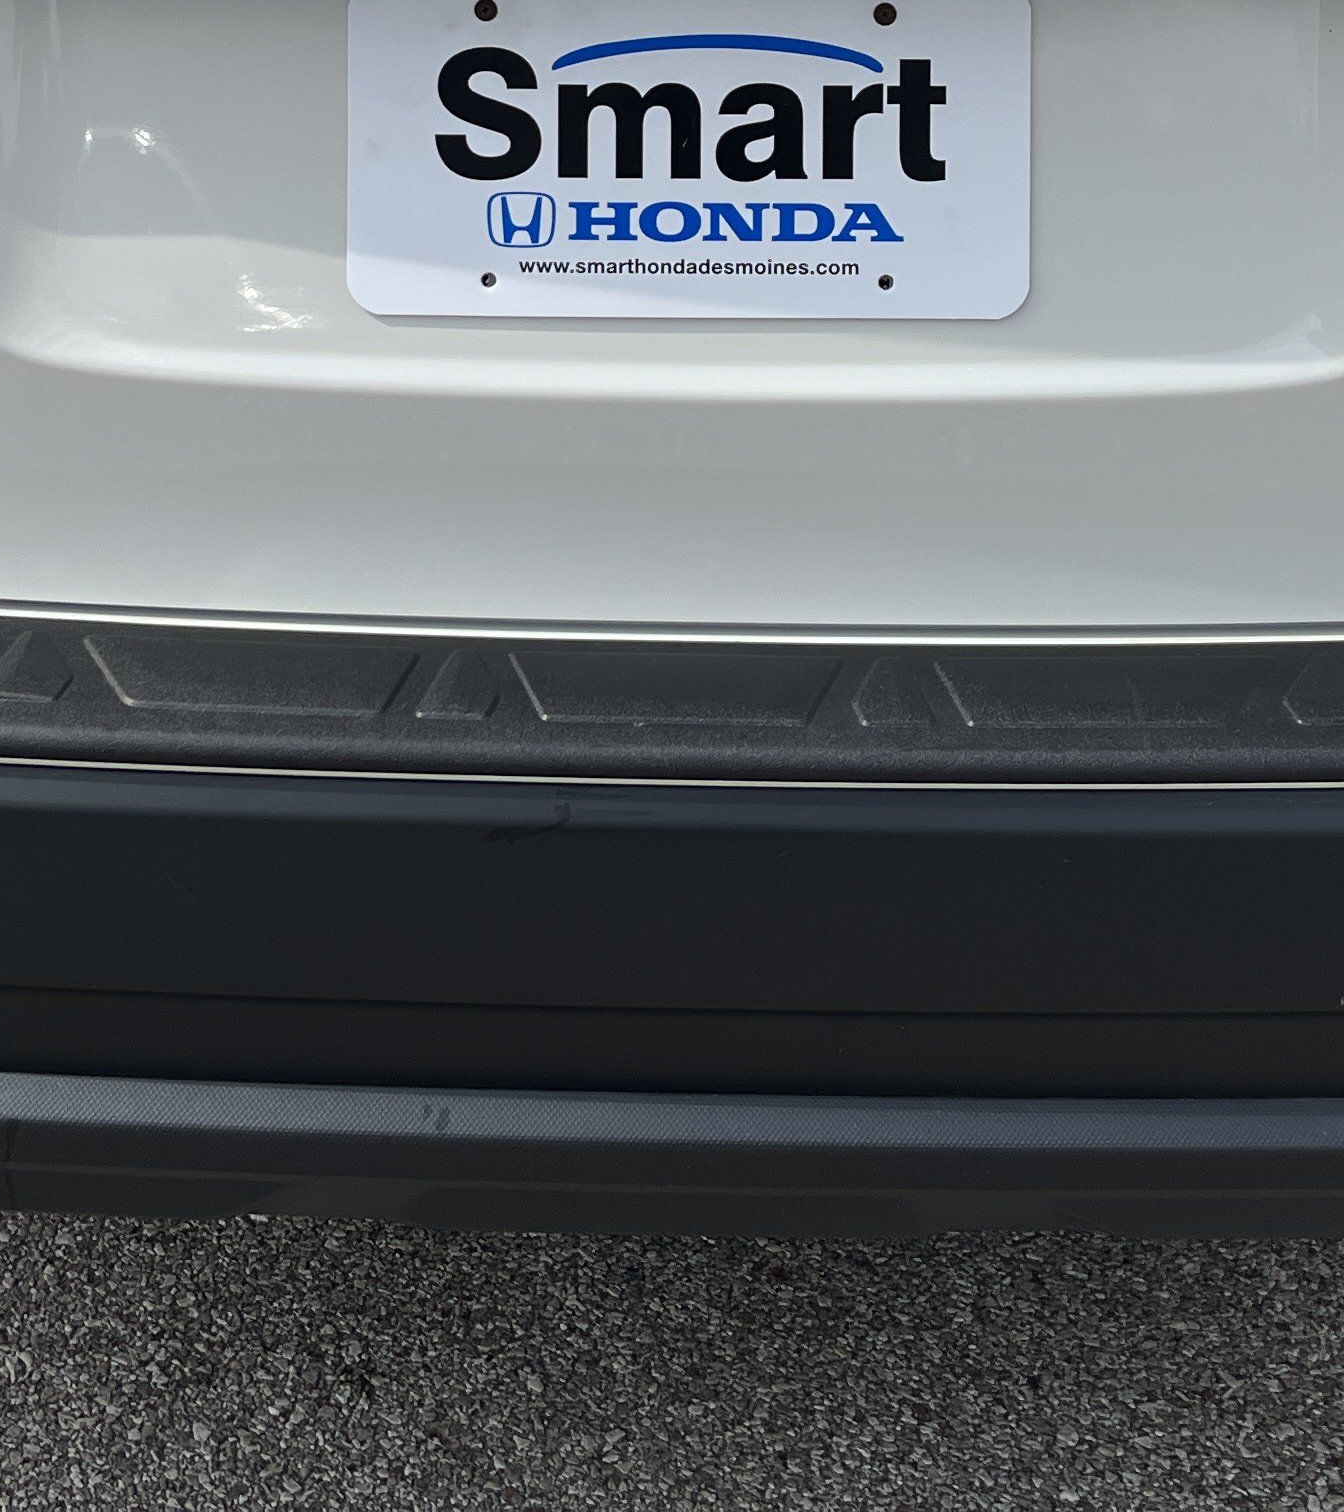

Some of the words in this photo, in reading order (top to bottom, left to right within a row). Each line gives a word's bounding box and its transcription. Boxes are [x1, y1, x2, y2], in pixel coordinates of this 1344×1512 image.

[435, 46, 946, 182] Smart
[568, 201, 905, 243] HONDA
[519, 258, 859, 276] www.smarthondadesmoines.com
